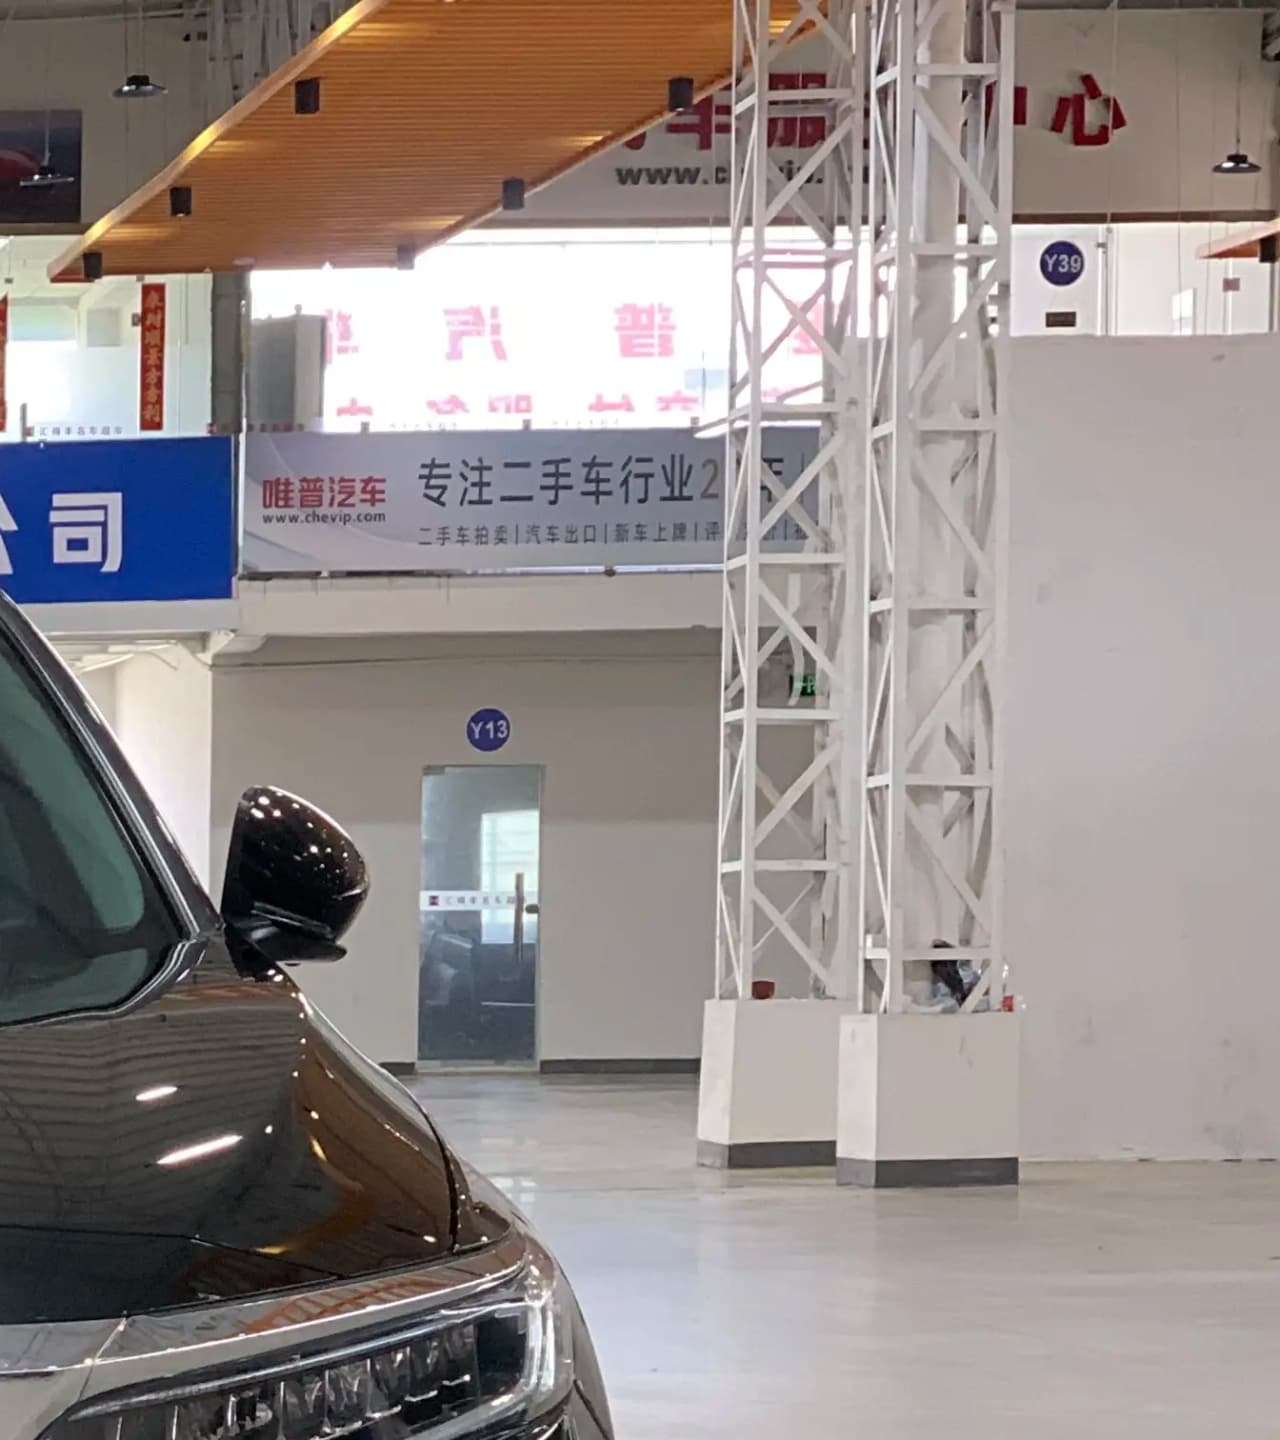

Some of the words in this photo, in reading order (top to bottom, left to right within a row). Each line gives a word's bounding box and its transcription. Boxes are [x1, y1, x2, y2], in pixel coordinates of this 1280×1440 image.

[1044, 253, 1082, 273] Y39
[418, 453, 785, 508] 专注二手车行业2
[262, 476, 387, 509] 唯普汽车
[262, 510, 387, 525] www.chevip.com
[469, 719, 509, 740] Y13
